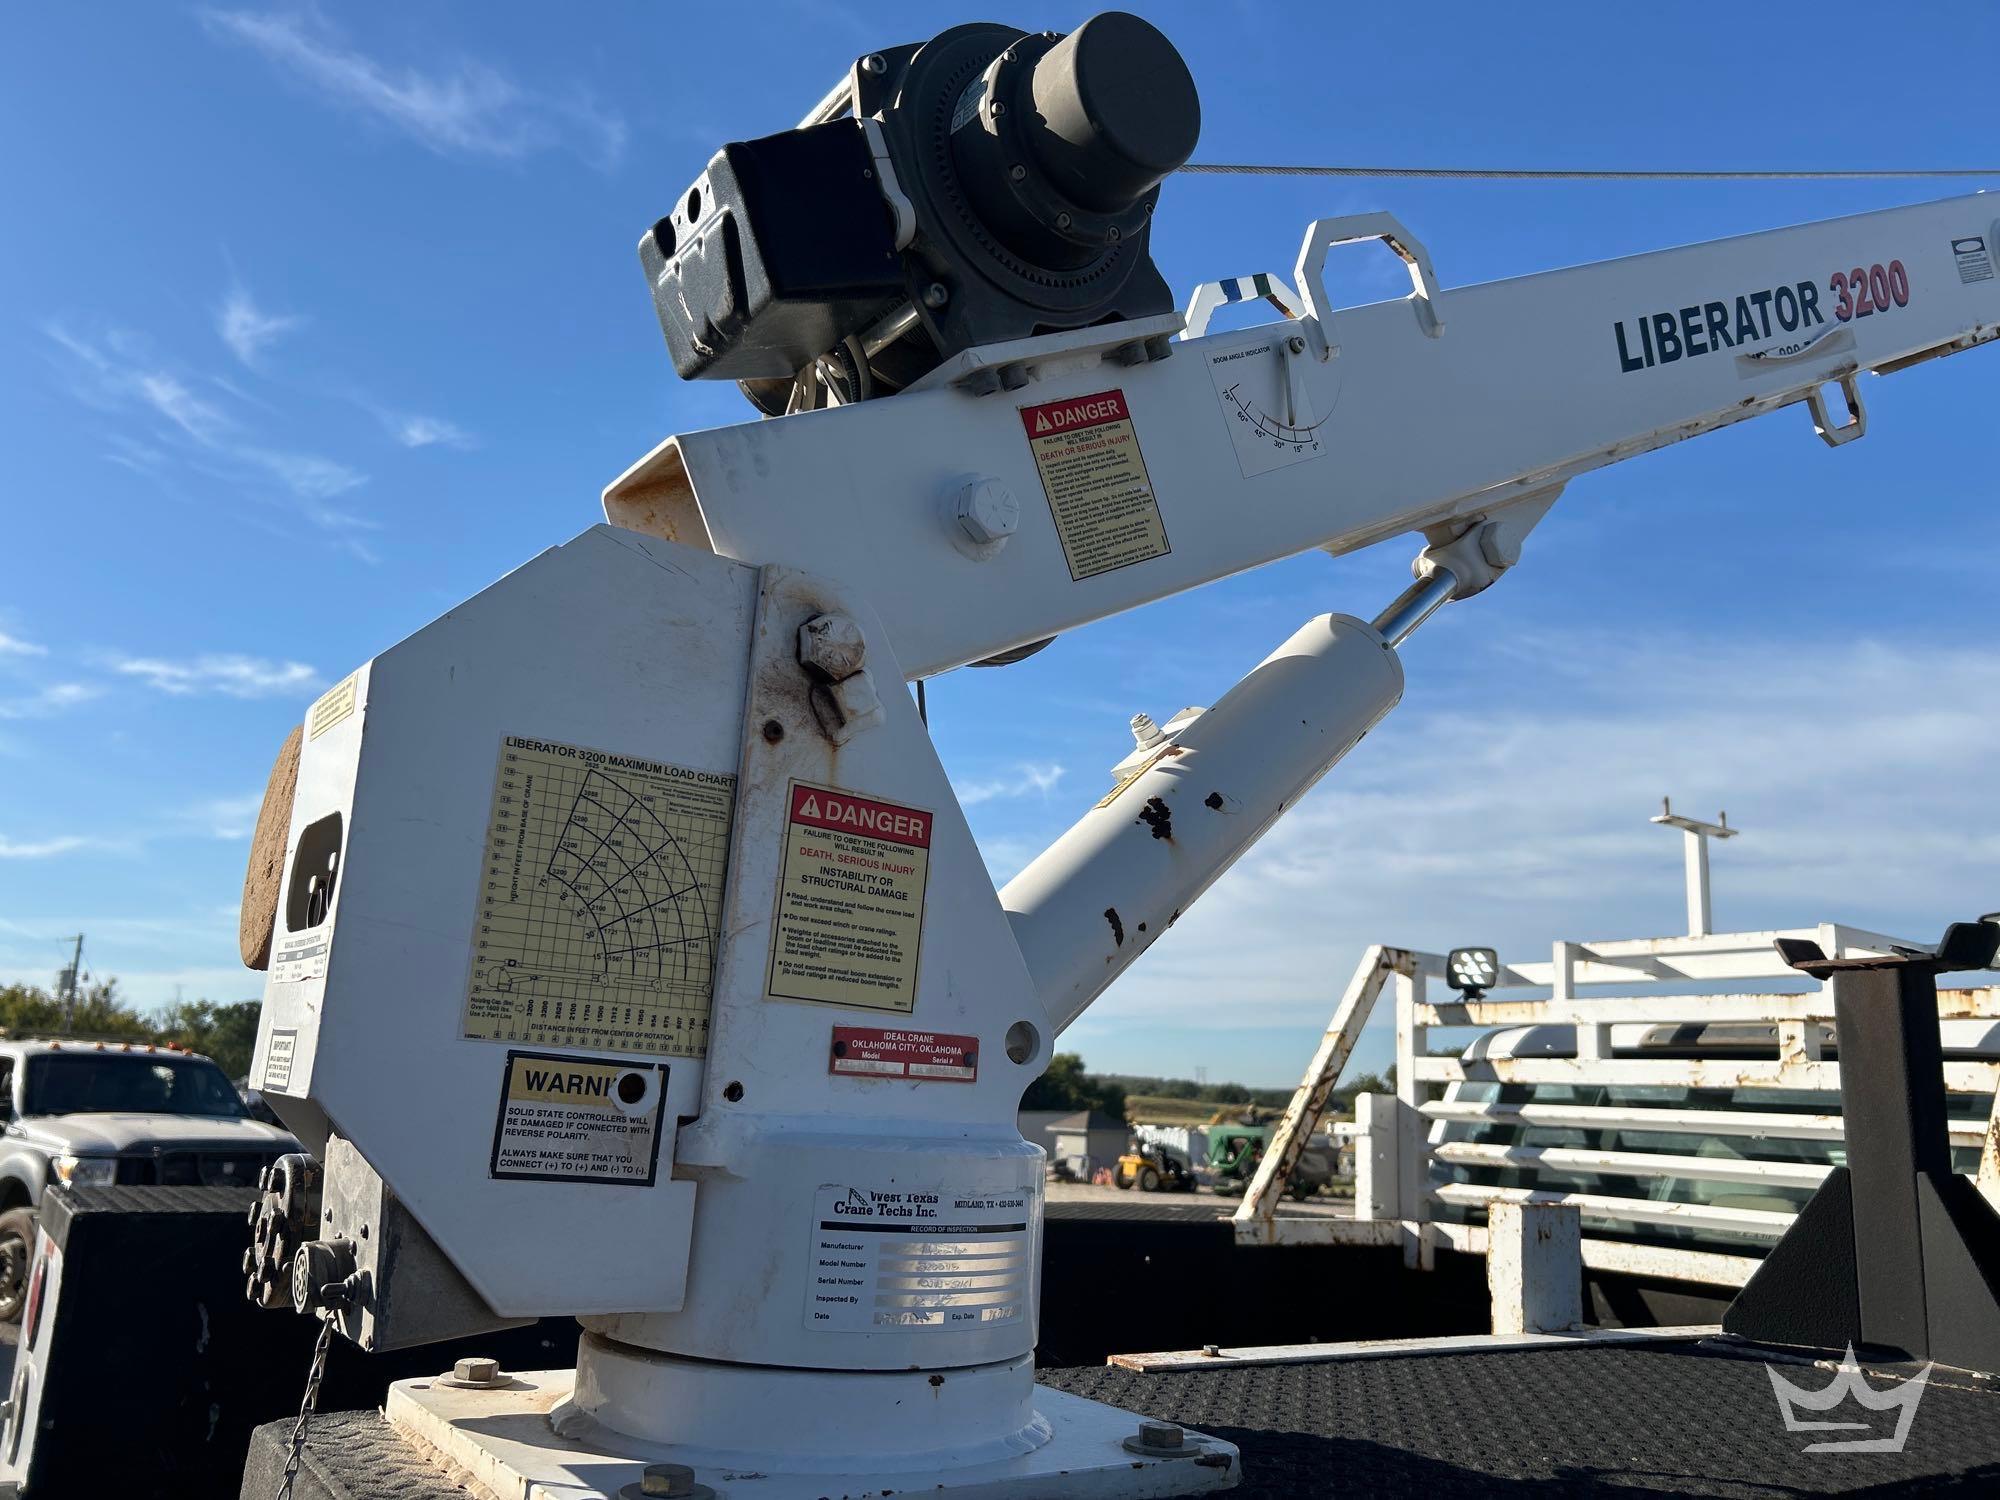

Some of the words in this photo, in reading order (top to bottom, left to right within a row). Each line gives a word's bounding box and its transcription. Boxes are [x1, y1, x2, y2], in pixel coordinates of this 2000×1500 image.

[1614, 280, 1825, 373] LIBERATOR
[1830, 259, 1910, 323] 3200
[1213, 355, 1228, 364] BOOM
[1228, 352, 1245, 360] ANGLE
[1245, 345, 1270, 357] INDICATOR
[1052, 398, 1120, 427] DANGER
[1040, 449, 1064, 461] DEATH
[1064, 446, 1077, 456] OR
[1077, 440, 1107, 453] SERIOUS
[1107, 434, 1131, 446] INJURY
[506, 736, 576, 759] LIBERATOR
[579, 750, 606, 763] 3200
[608, 755, 662, 775] MAXIMUM
[664, 765, 695, 780] LOAD
[697, 769, 736, 787] CHART
[524, 775, 534, 799] CRANE
[523, 800, 530, 809] OF
[520, 809, 529, 827] BASE
[825, 800, 924, 839] DANGER
[517, 829, 526, 848] FROM
[803, 829, 831, 840] FAILURE
[843, 837, 861, 845] OBEY
[862, 840, 876, 848] THE
[877, 843, 914, 856] FOLLOWING
[834, 843, 850, 851] WILL
[852, 846, 876, 856] RESULT
[514, 850, 523, 867] FEET
[800, 847, 835, 861] DEATH,
[838, 854, 880, 869] SERIOUS
[882, 862, 915, 876] INJURY
[820, 866, 877, 884] INSTABILITY
[879, 877, 893, 887] OR
[509, 876, 519, 902] HEIGHT
[801, 874, 866, 893] STRUCTURAL
[868, 886, 908, 901] DAMAGE
[531, 1023, 565, 1032] DISTANCE
[644, 1033, 673, 1041] ROTATION
[883, 1032, 906, 1041] IDEAL
[908, 1034, 934, 1043] CRANE
[852, 1039, 897, 1050] OKLAHOMA
[898, 1043, 918, 1052] CITY,
[920, 1045, 962, 1055] OKLAHOMA
[862, 1051, 880, 1059] Model
[932, 1056, 948, 1064] Serial
[523, 1070, 617, 1098] WARNI
[508, 1108, 534, 1117] SOLID
[537, 1110, 564, 1119] STATE
[566, 1112, 627, 1123] CONTROLLERS
[629, 1117, 649, 1125] WILL
[505, 1128, 544, 1138] REVERSE
[547, 1131, 591, 1141] POLARITY.
[506, 1118, 518, 1126] BE
[521, 1119, 564, 1129] DAMAGED
[577, 1123, 628, 1133] CONNECTED
[630, 1127, 650, 1135] WITH
[501, 1149, 537, 1158] ALWAYS
[540, 1151, 564, 1160] MAKE
[566, 1153, 589, 1161] SURE
[591, 1154, 613, 1162] THAT
[500, 1159, 542, 1169] CONNECT
[545, 1162, 558, 1170] (+)
[575, 1163, 588, 1172] (+)
[590, 1164, 609, 1172] AND
[611, 1165, 620, 1174] (-)
[635, 1167, 647, 1175] (-).
[870, 1191, 901, 1203] West
[906, 1193, 939, 1204] Texas
[954, 1200, 985, 1210] MIDLAND,
[834, 1201, 873, 1216] Crane
[877, 1203, 913, 1216] Techs
[916, 1206, 937, 1217] Inc.
[821, 1242, 864, 1250] Manufacturer
[819, 1259, 840, 1268] Model
[841, 1260, 867, 1268] Number
[818, 1277, 837, 1285] Serial
[838, 1278, 864, 1286] Number
[816, 1295, 849, 1304] Inspected
[851, 1296, 859, 1304] By
[952, 1313, 962, 1321] Exp.
